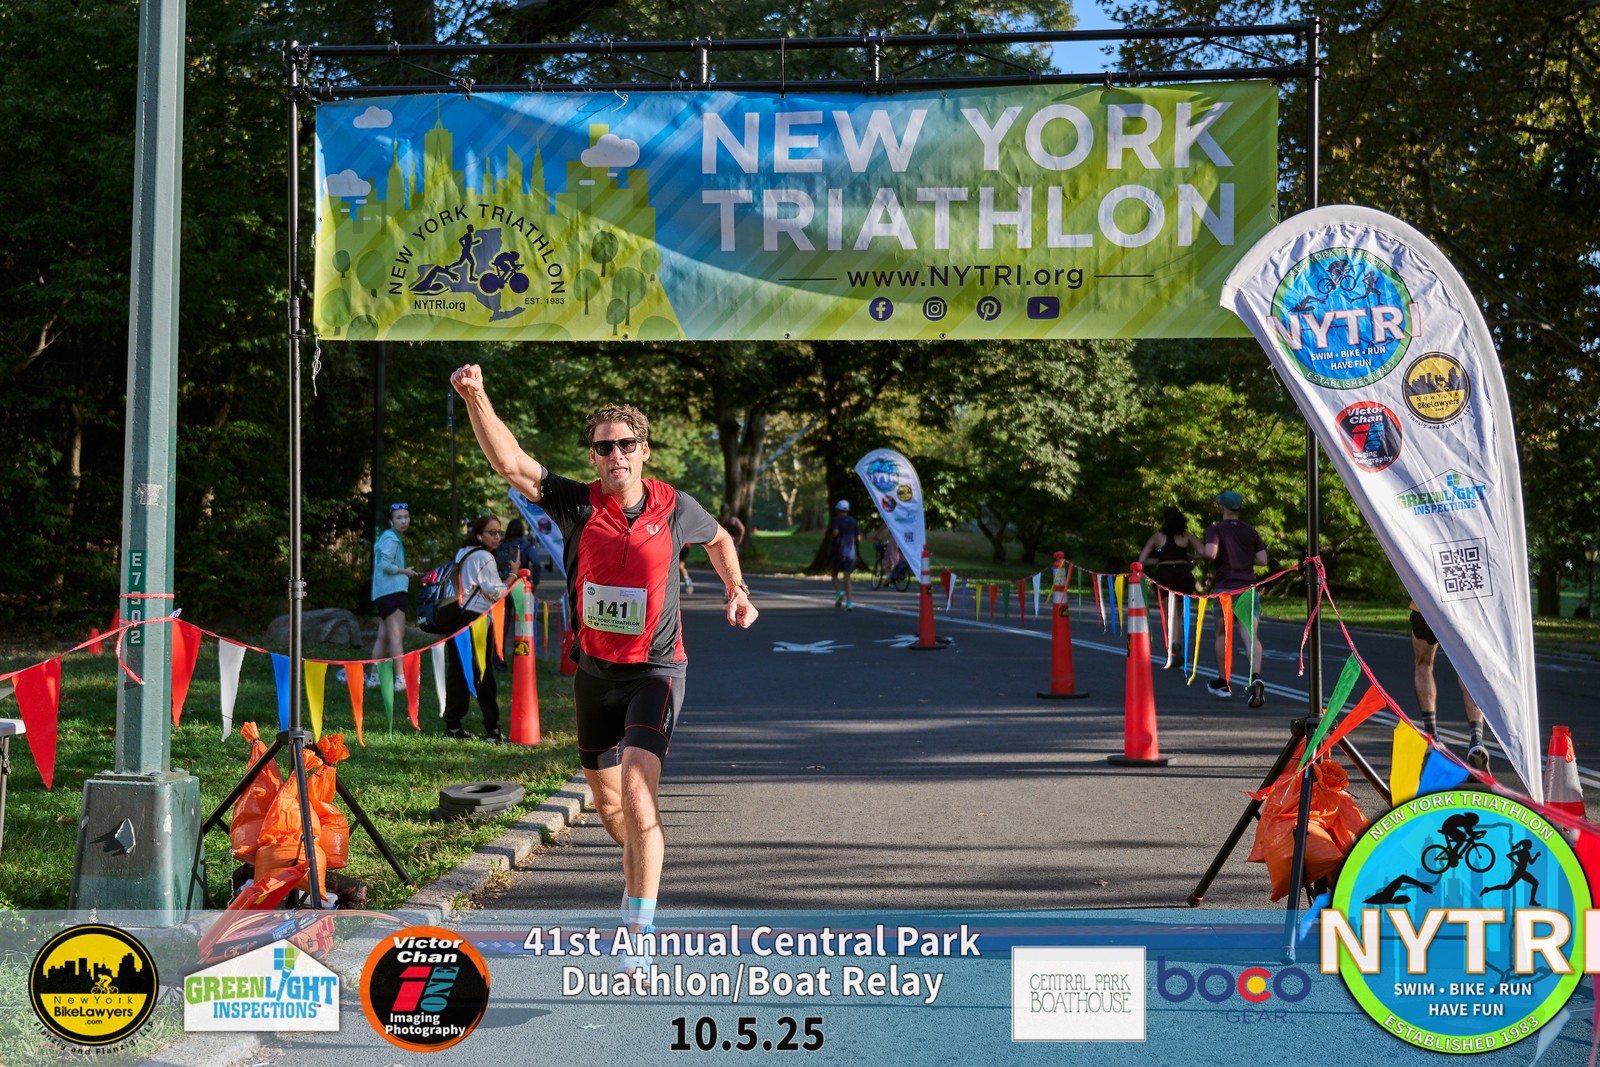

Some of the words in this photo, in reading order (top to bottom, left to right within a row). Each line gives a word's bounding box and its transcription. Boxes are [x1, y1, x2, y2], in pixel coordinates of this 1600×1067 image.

[701, 109, 927, 174] NEW
[961, 101, 1233, 171] YORK
[702, 182, 1236, 252] TRIATHLON
[389, 245, 414, 294] NEW
[412, 204, 468, 241] YORK
[478, 203, 565, 294] TRIATHLON
[847, 265, 1084, 290] www.NYTRI.org
[414, 300, 466, 311] NYTRI.org
[1266, 302, 1422, 350] NYTRI
[1311, 351, 1334, 361] SWIM
[1341, 349, 1360, 357] BIKE
[1368, 346, 1386, 355] RUN
[1330, 361, 1353, 370] HAVE
[1355, 359, 1372, 368] FUN
[1306, 372, 1370, 389] ESTABLISHED
[1372, 364, 1391, 380] 1983
[1347, 406, 1385, 416] Victor
[1418, 398, 1460, 409] BikeLawyers
[1349, 415, 1383, 425] Chan
[1413, 500, 1477, 515] INSPECTIONS
[596, 600, 628, 618] 141
